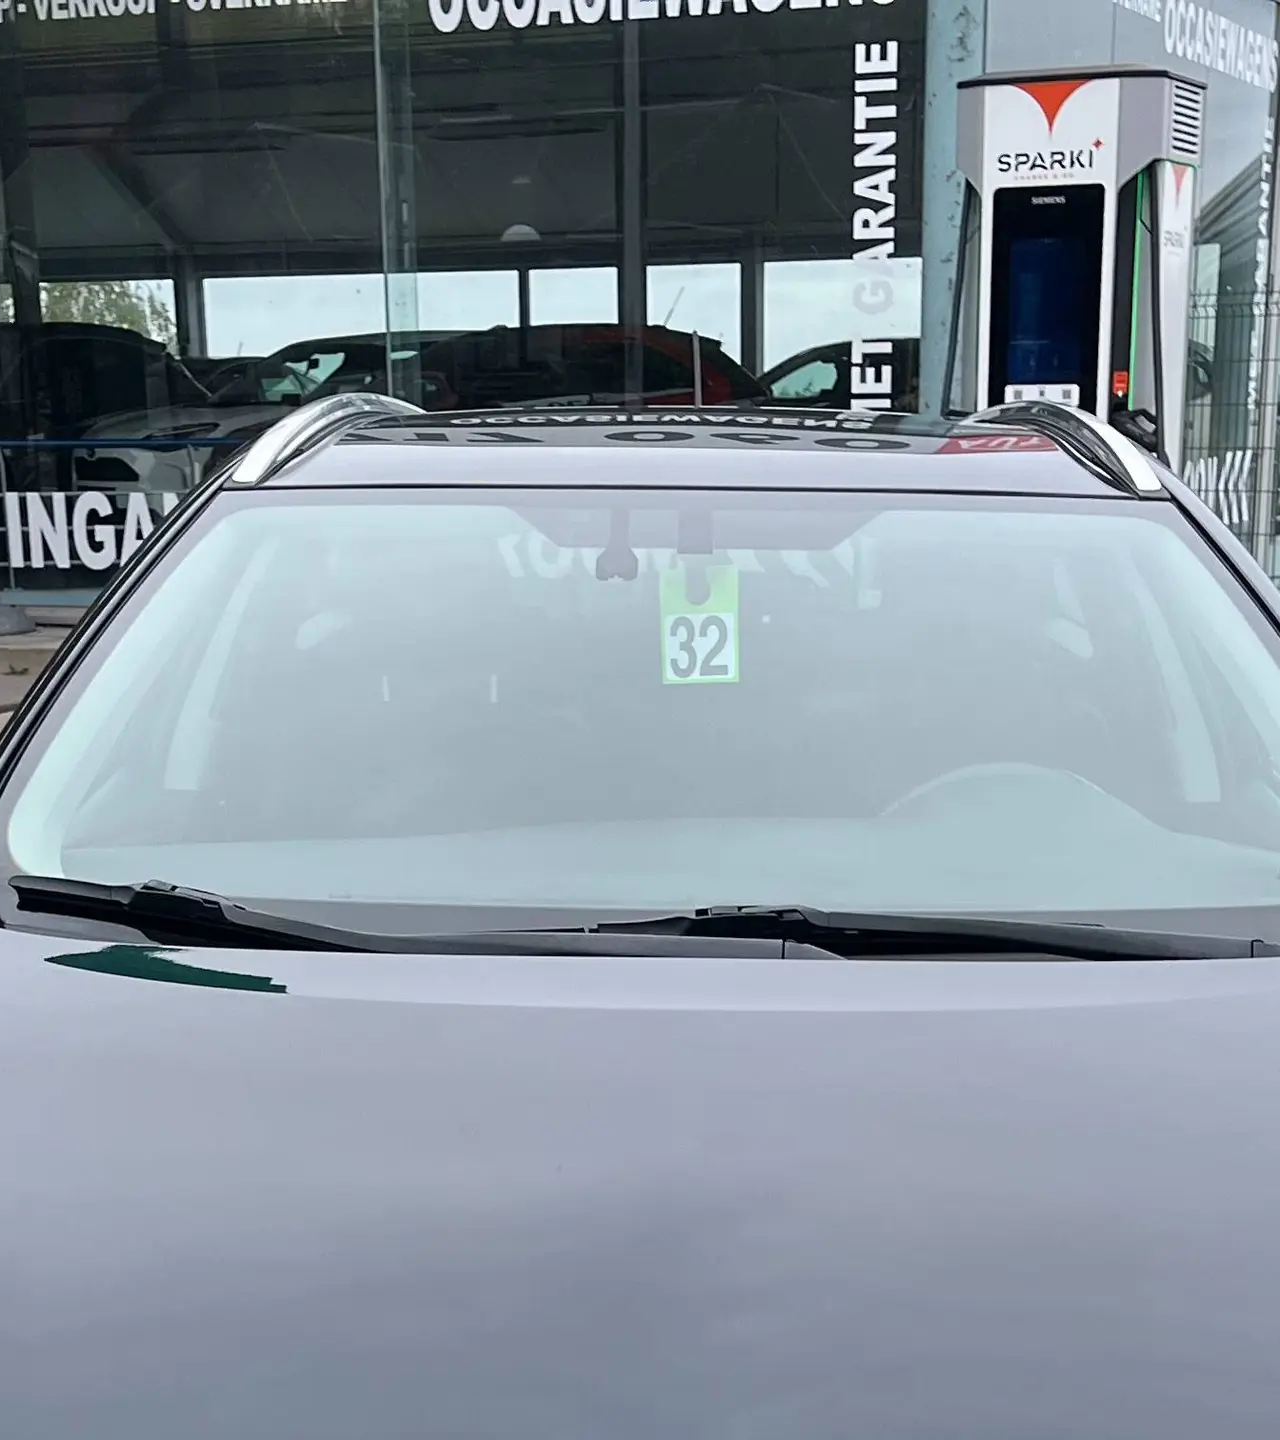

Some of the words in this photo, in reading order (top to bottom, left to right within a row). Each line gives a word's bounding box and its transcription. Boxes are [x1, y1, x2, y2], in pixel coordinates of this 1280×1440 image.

[852, 40, 899, 315] GARANTIE
[997, 149, 1094, 172] SPARKI
[8, 489, 182, 570] INGA
[670, 615, 729, 679] 32
